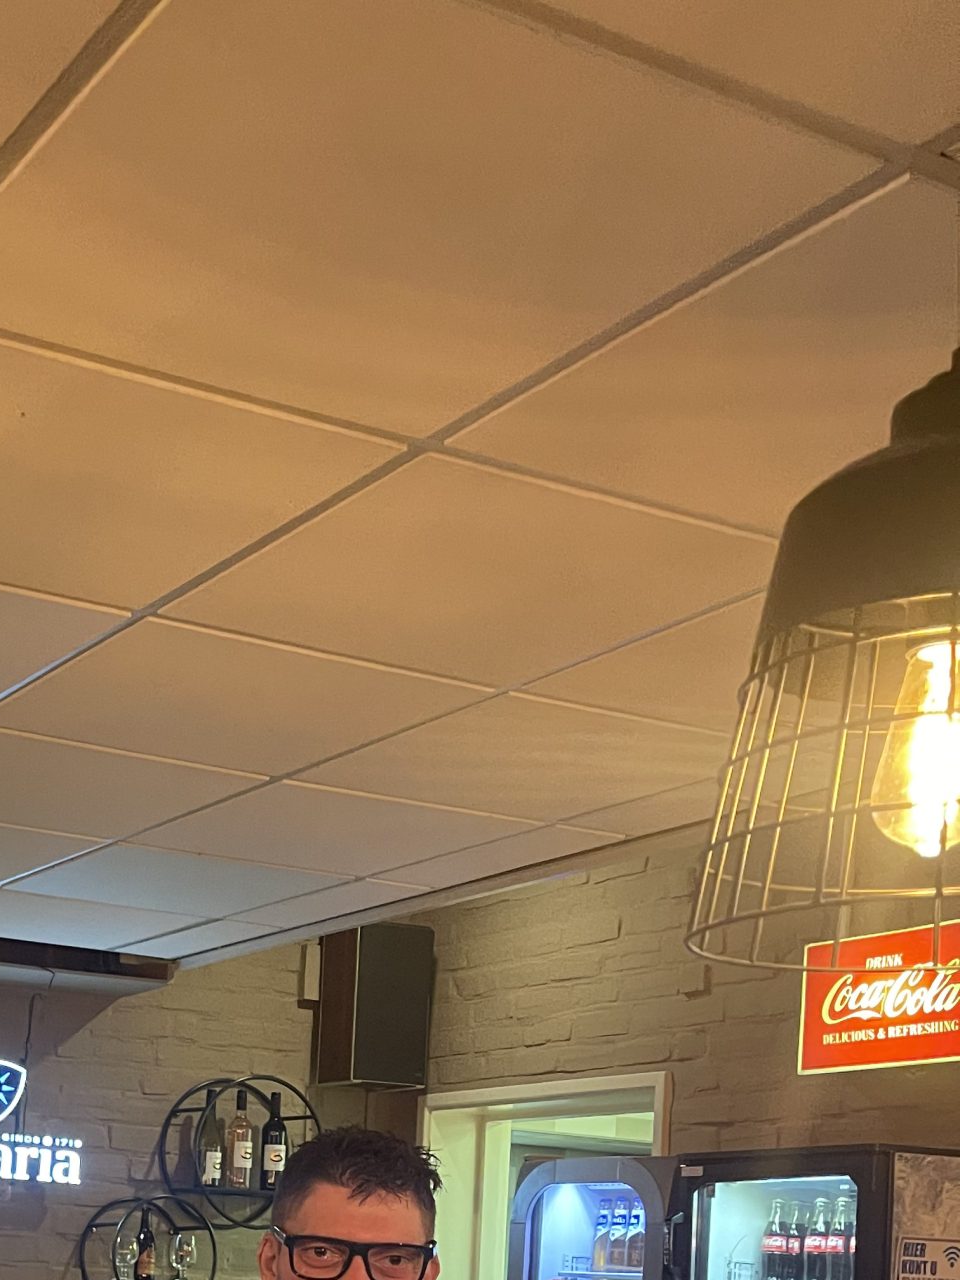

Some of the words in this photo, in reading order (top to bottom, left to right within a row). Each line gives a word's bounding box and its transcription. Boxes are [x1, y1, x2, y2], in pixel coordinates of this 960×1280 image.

[865, 953, 904, 971] DRINK
[822, 1029, 875, 1045] DELICIOUS
[877, 1027, 887, 1040] &
[887, 1019, 960, 1038] REFRESHING
[902, 1241, 927, 1257] HIER
[901, 1259, 929, 1275] KUNT
[930, 1260, 938, 1276] U
